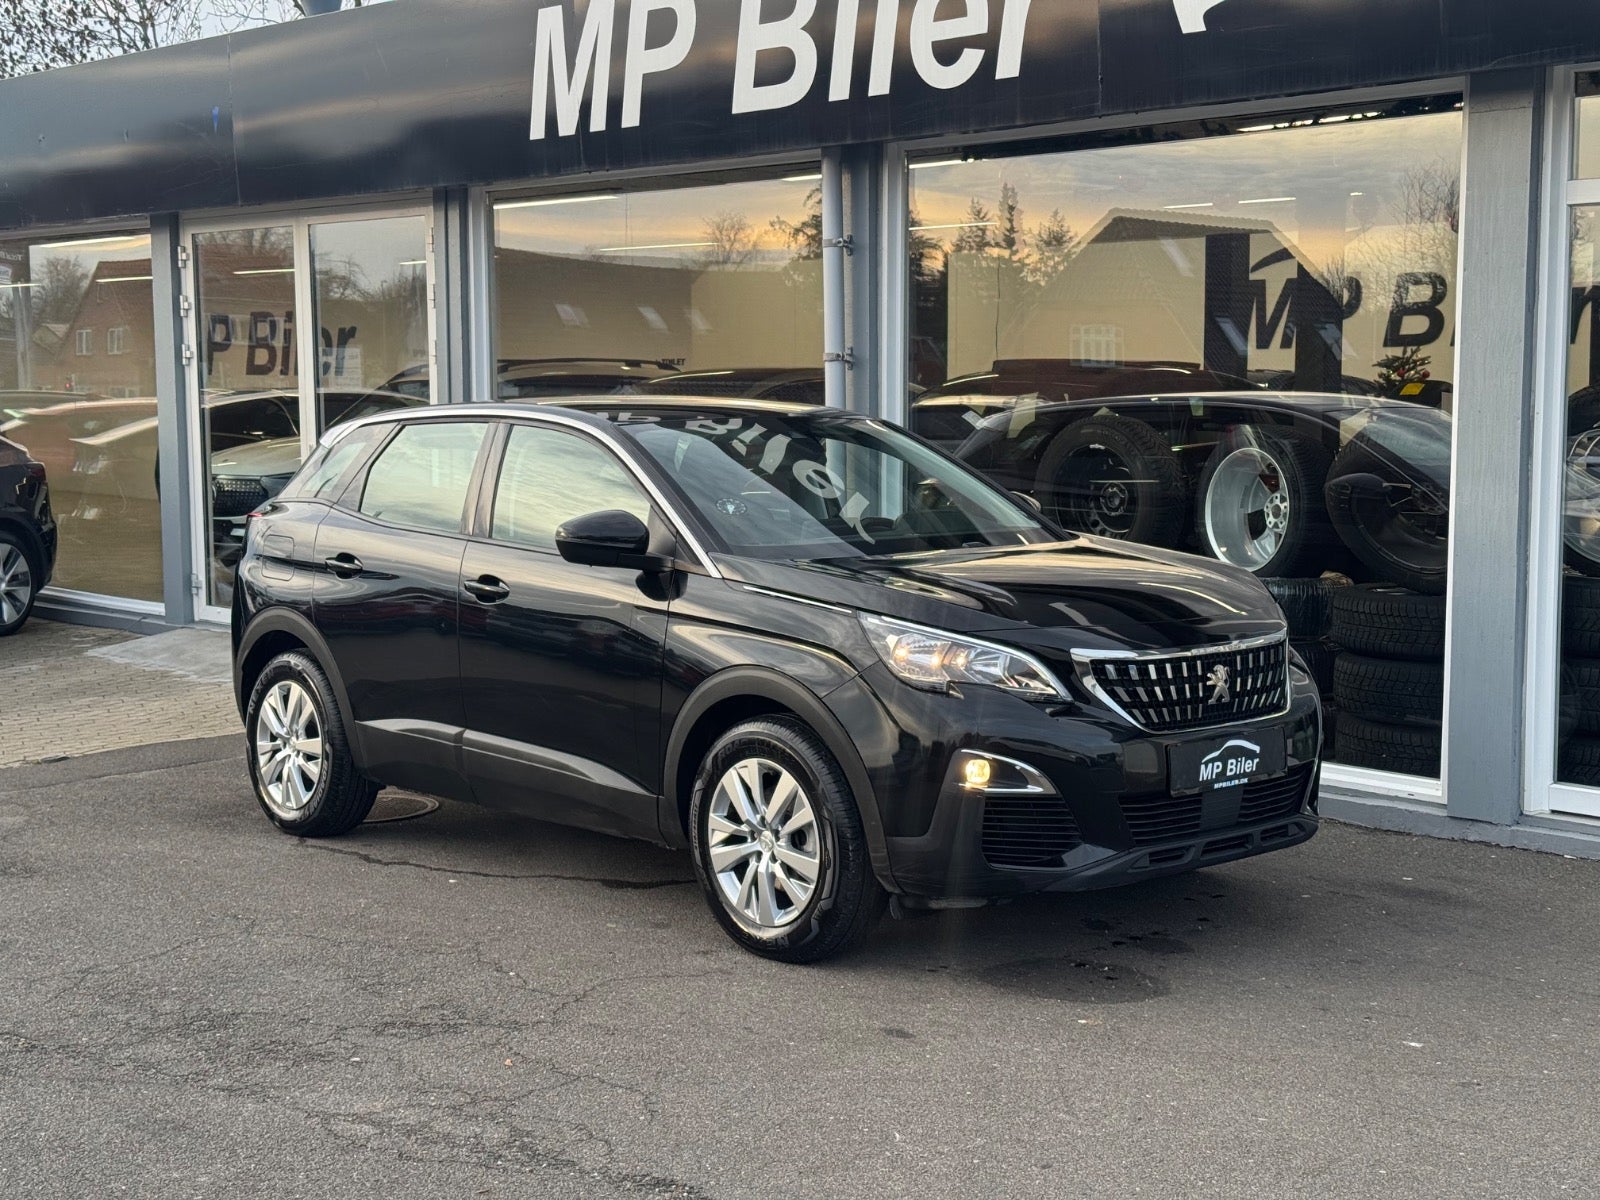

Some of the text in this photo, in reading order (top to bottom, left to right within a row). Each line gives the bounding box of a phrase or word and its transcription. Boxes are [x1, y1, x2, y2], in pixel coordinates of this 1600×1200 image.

[529, 0, 1033, 140] MP Biler
[1199, 757, 1259, 781] MP Biler
